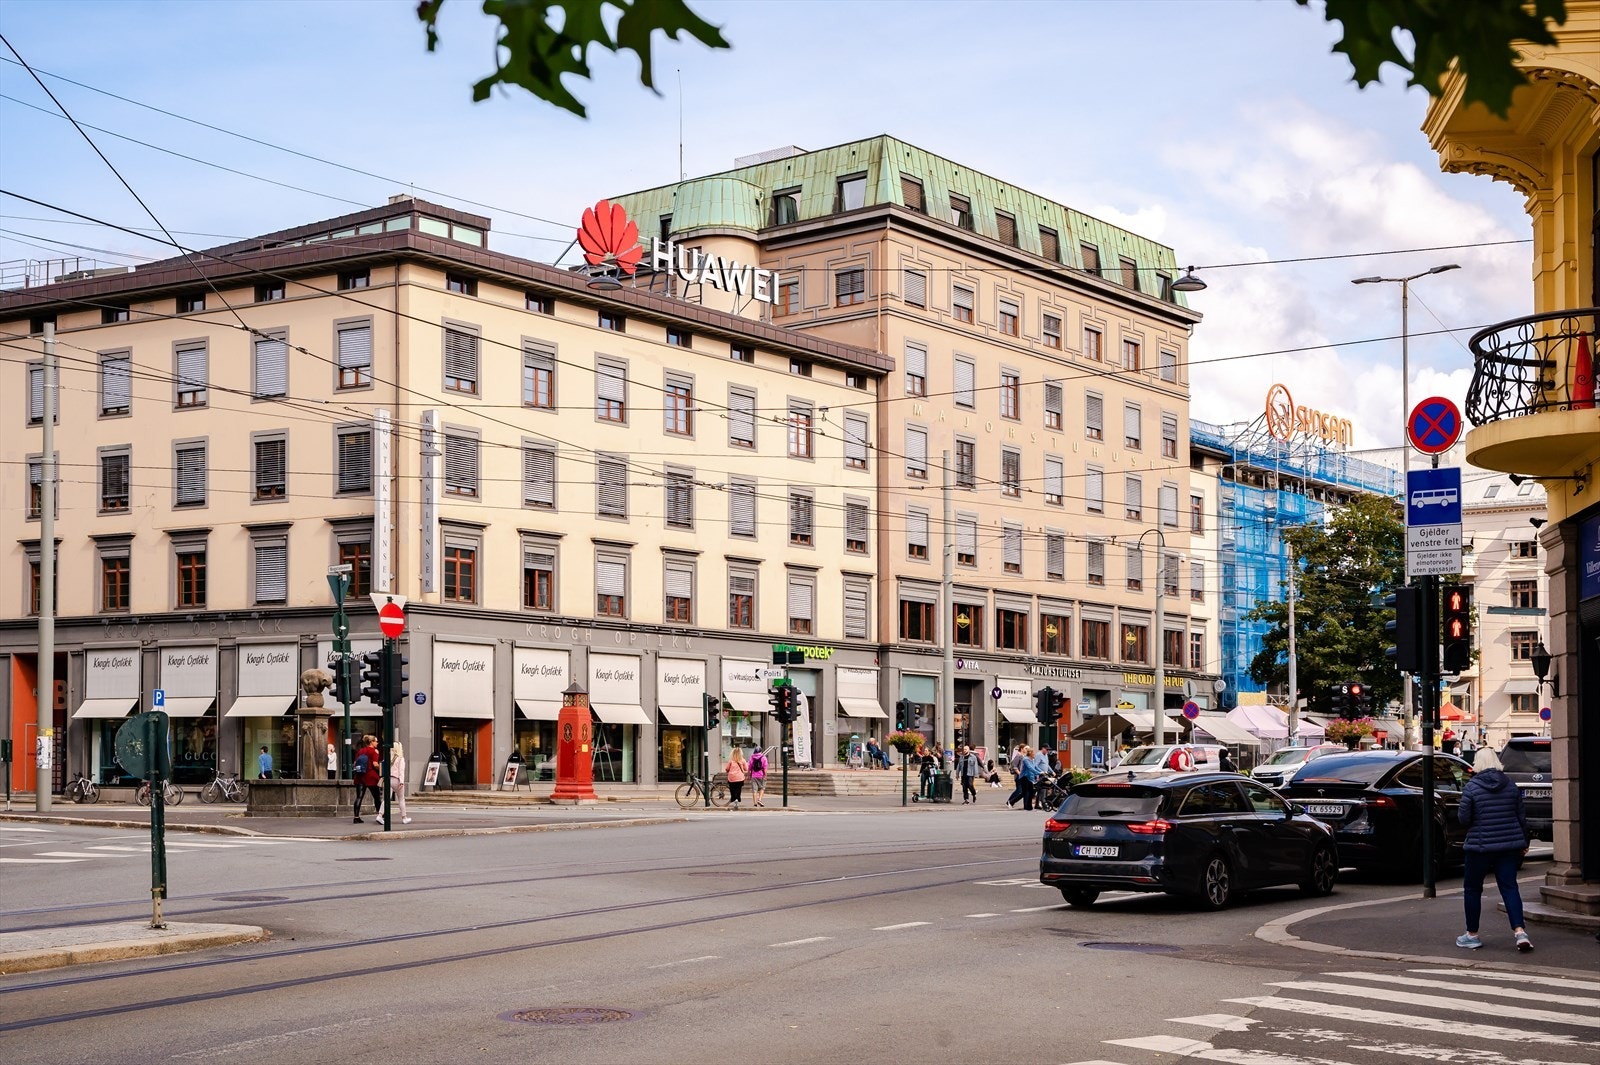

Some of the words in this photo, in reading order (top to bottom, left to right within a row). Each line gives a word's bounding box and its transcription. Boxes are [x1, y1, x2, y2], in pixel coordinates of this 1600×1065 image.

[651, 236, 780, 305] HUAWEI
[914, 404, 1172, 475] MAJORSTUHUSET
[1420, 528, 1449, 538] Gjelder
[1411, 539, 1441, 548] venstre
[1444, 537, 1459, 546] felt
[1429, 565, 1457, 574] passasjer
[103, 622, 170, 639] KROGH
[193, 619, 282, 635] OPTIKK
[526, 623, 593, 642] KROGH
[614, 631, 694, 649] OPTIKK
[93, 657, 112, 670] Krogh
[112, 656, 133, 669] Optikk
[168, 654, 186, 667] Krogh
[187, 654, 209, 667] Optikk
[247, 652, 264, 667] Krogh
[266, 652, 289, 665] Optikk
[441, 657, 460, 673] Krogh
[462, 657, 485, 672] Optikk
[964, 661, 979, 671] VITA
[521, 662, 539, 677] Krogh
[541, 663, 562, 676] Optikk
[596, 668, 612, 682] Krogh
[614, 669, 635, 682] Optikk
[764, 671, 781, 679] Politi
[664, 672, 679, 685] Krogh
[681, 673, 700, 685] Optikk
[1123, 673, 1136, 684] THE
[1138, 674, 1152, 685] OLD
[1172, 676, 1184, 687] PUB
[1526, 789, 1535, 797] PP
[1310, 805, 1318, 813] EK
[1081, 846, 1091, 855] CH
[1094, 847, 1116, 856] 10203
